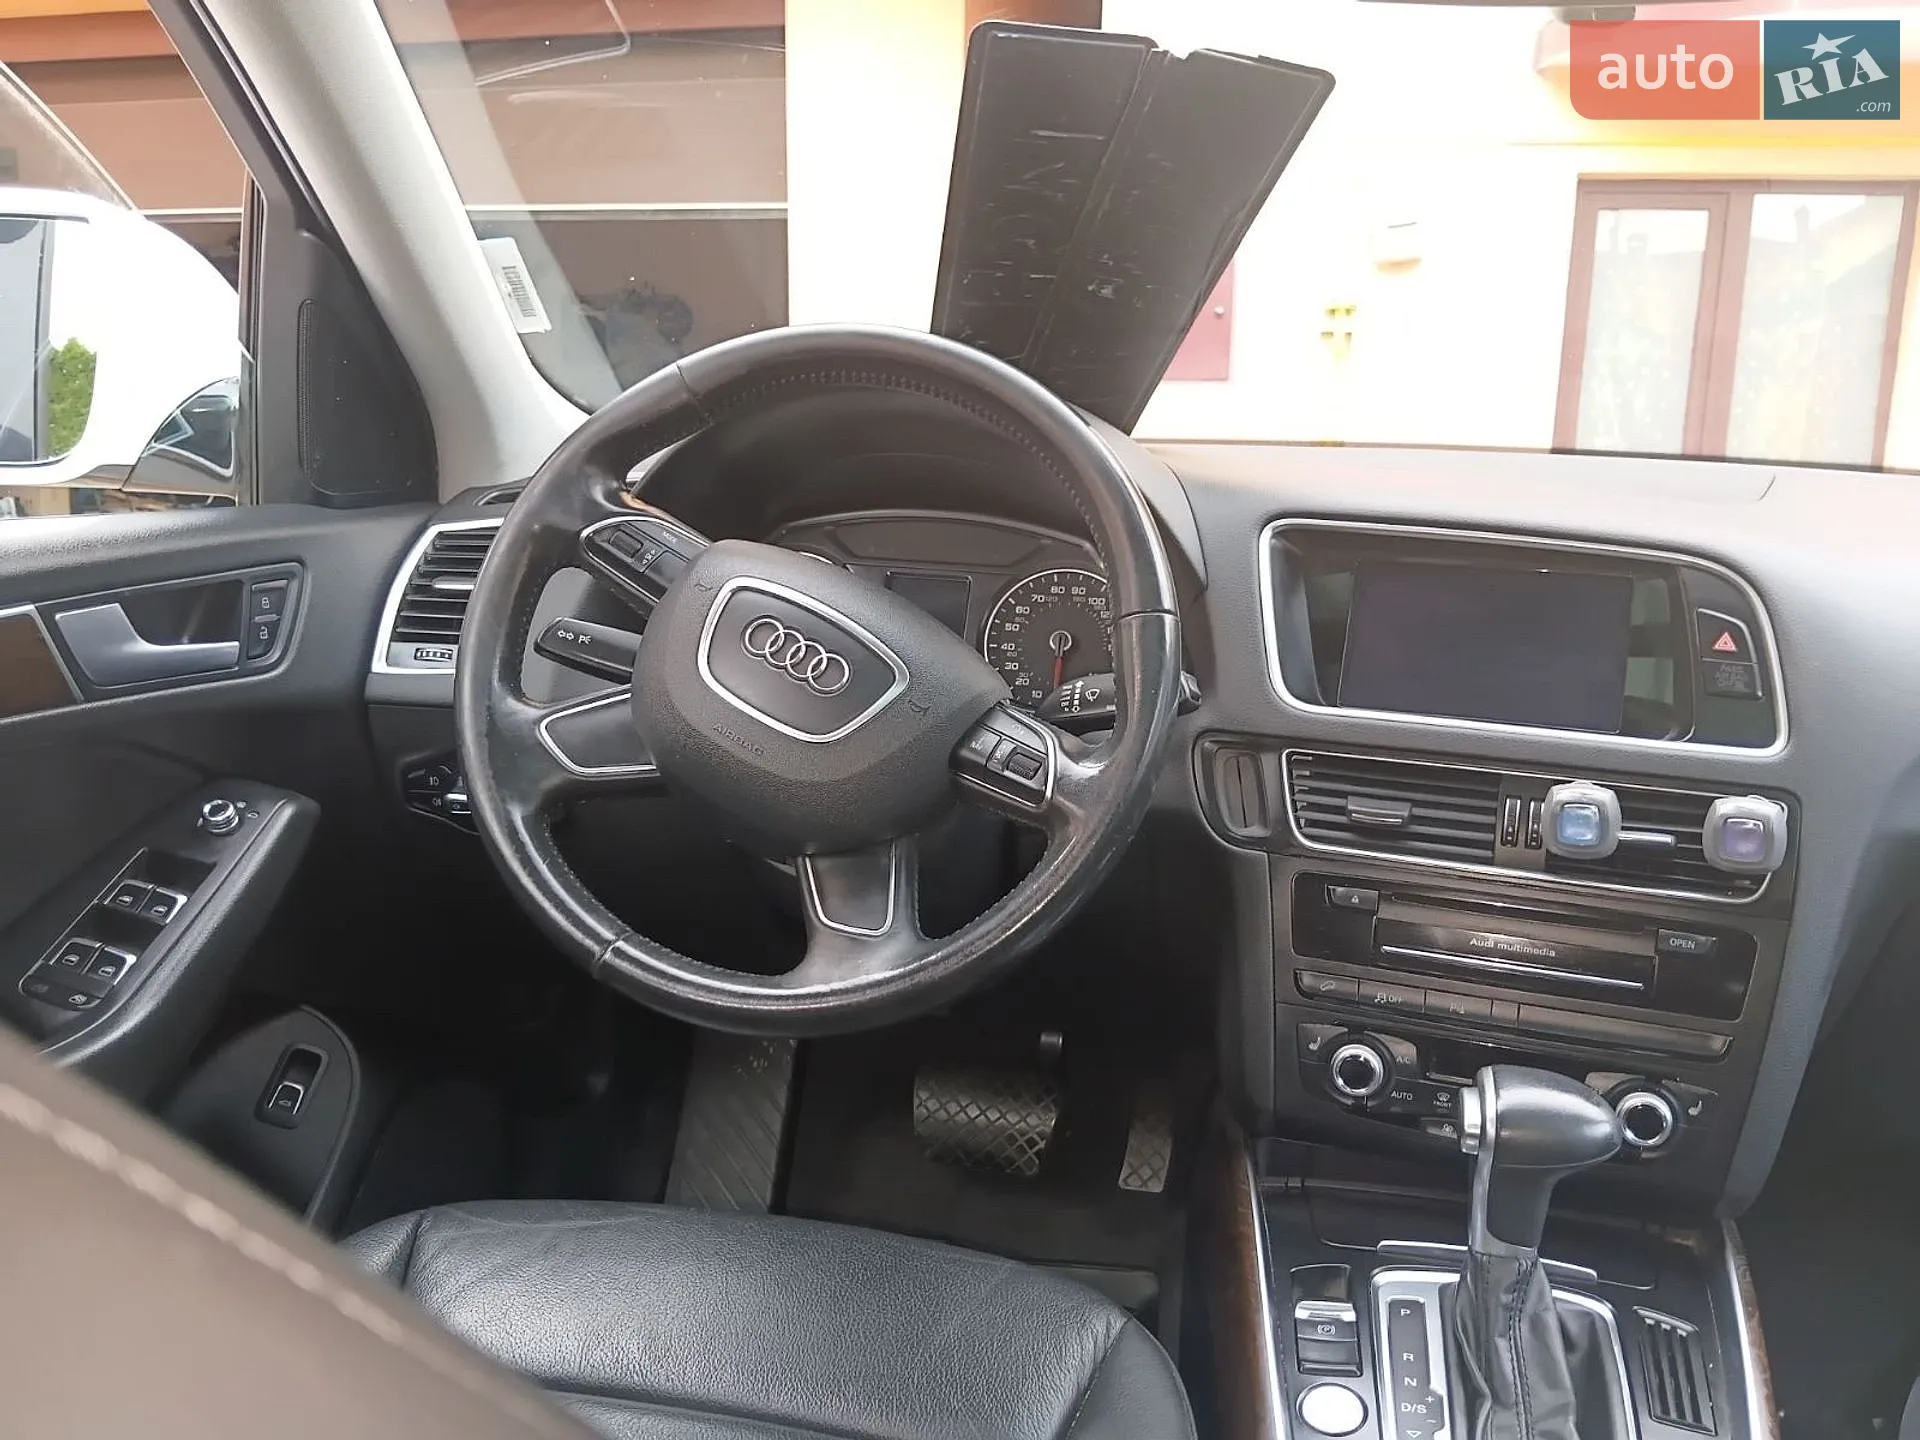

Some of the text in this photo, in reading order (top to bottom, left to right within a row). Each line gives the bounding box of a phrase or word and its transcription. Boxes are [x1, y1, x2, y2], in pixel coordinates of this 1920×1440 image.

[1050, 585, 1065, 594] 80
[1071, 586, 1086, 595] 90
[1031, 594, 1045, 603] 70
[1088, 597, 1106, 605] 100
[1005, 623, 1020, 631] 50
[1001, 643, 1016, 651] 40
[1004, 662, 1019, 670] 30
[1015, 677, 1030, 686] 20
[1031, 690, 1043, 698] 10
[712, 722, 765, 757] AIRBAG
[1469, 936, 1556, 957] Audi multimedia
[1669, 937, 1696, 950] OPEN
[1390, 1090, 1413, 1101] AUTO
[1400, 1308, 1411, 1317] P
[1402, 1352, 1414, 1362] R
[1404, 1376, 1418, 1387] N
[1401, 1402, 1428, 1414] D/S
